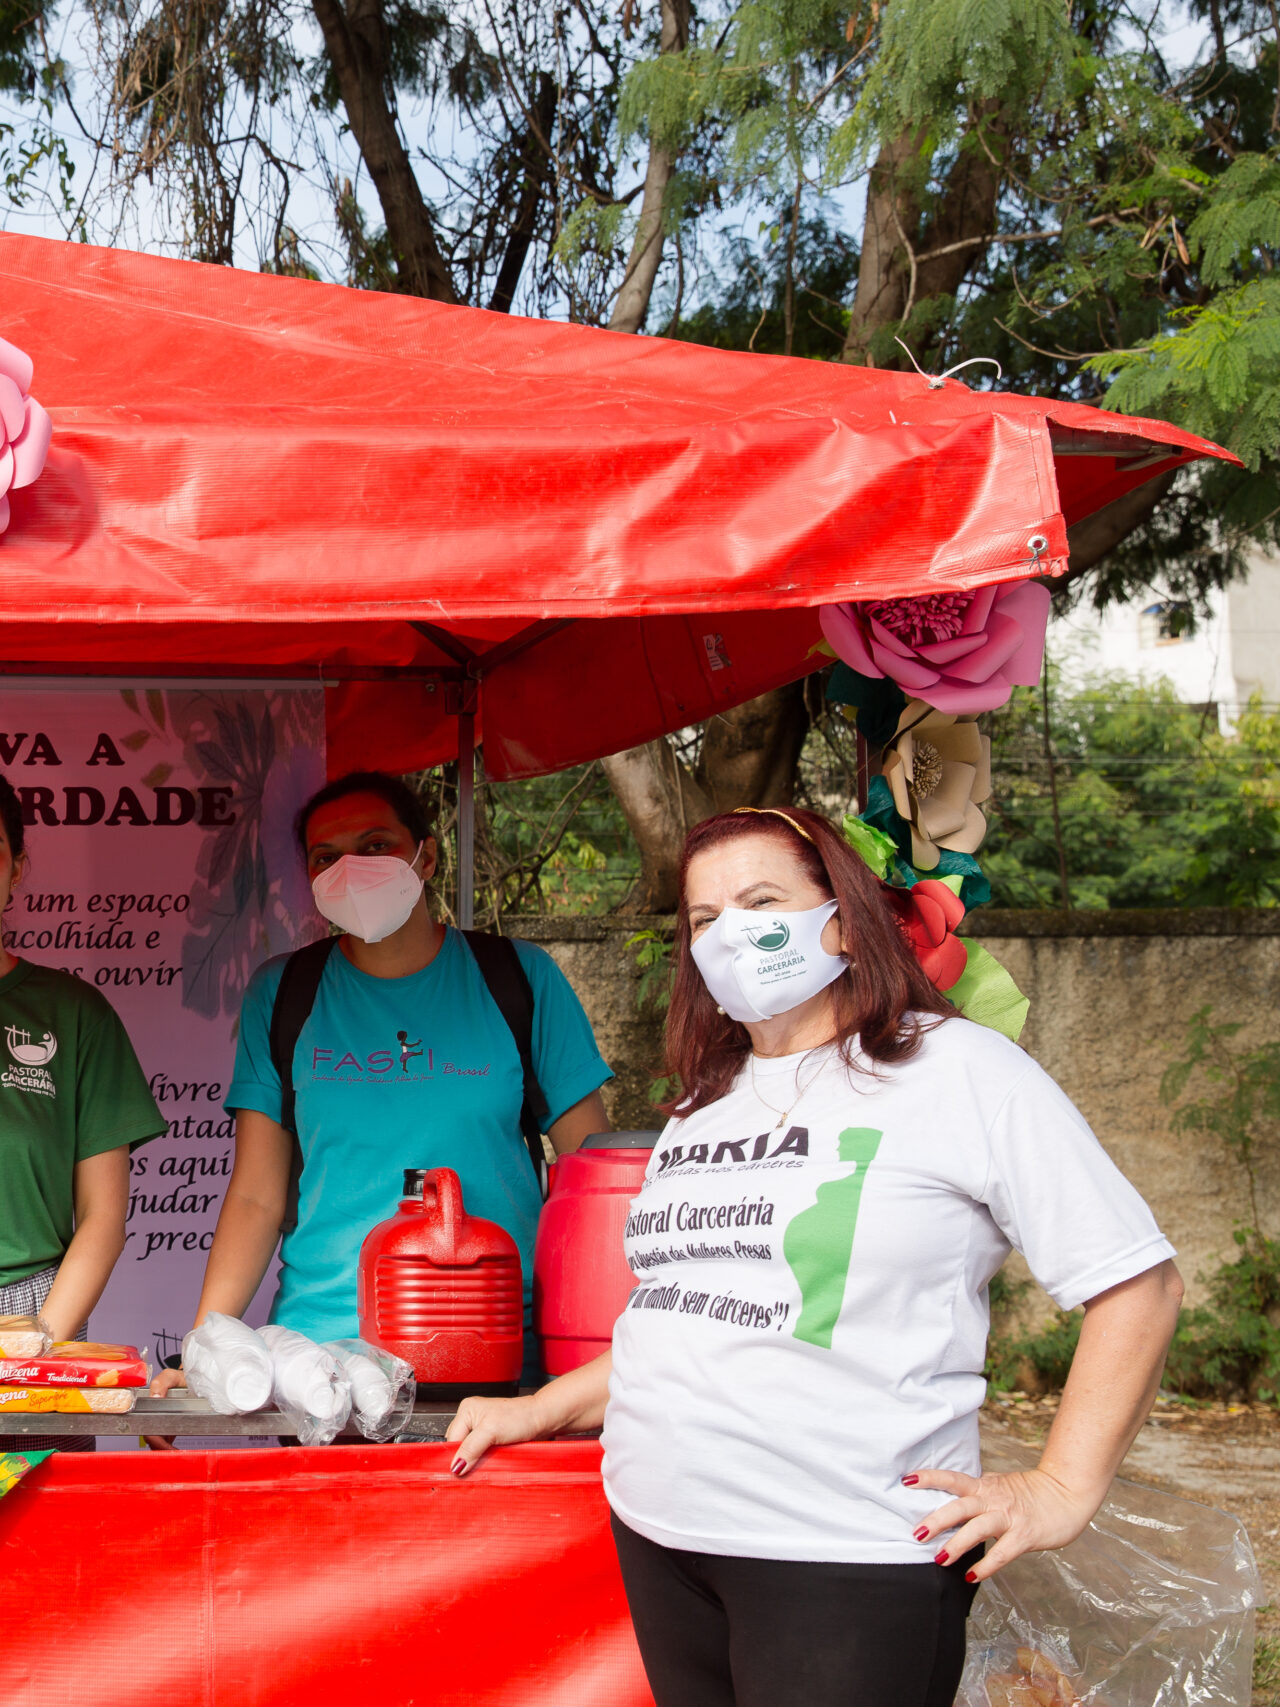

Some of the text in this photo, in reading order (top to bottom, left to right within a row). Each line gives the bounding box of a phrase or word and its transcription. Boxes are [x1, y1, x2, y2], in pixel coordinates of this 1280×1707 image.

[86, 733, 125, 766] A
[24, 894, 78, 913] um
[87, 894, 190, 922] espaço
[2, 921, 161, 949] acolhida e
[95, 961, 184, 986] ouvir
[9, 1064, 53, 1081] PASTORAL
[441, 1062, 490, 1077] Brasil
[150, 1073, 221, 1102] livre
[658, 1126, 809, 1172] MARIA
[159, 1150, 231, 1184] aqui
[125, 1184, 218, 1222] judar
[676, 1196, 775, 1232] Carcerária
[136, 1231, 213, 1261] prec
[686, 1243, 736, 1260] Mulheres
[734, 1240, 772, 1260] Presas
[679, 1290, 710, 1316] sem
[46, 1373, 88, 1383] Tradicional
